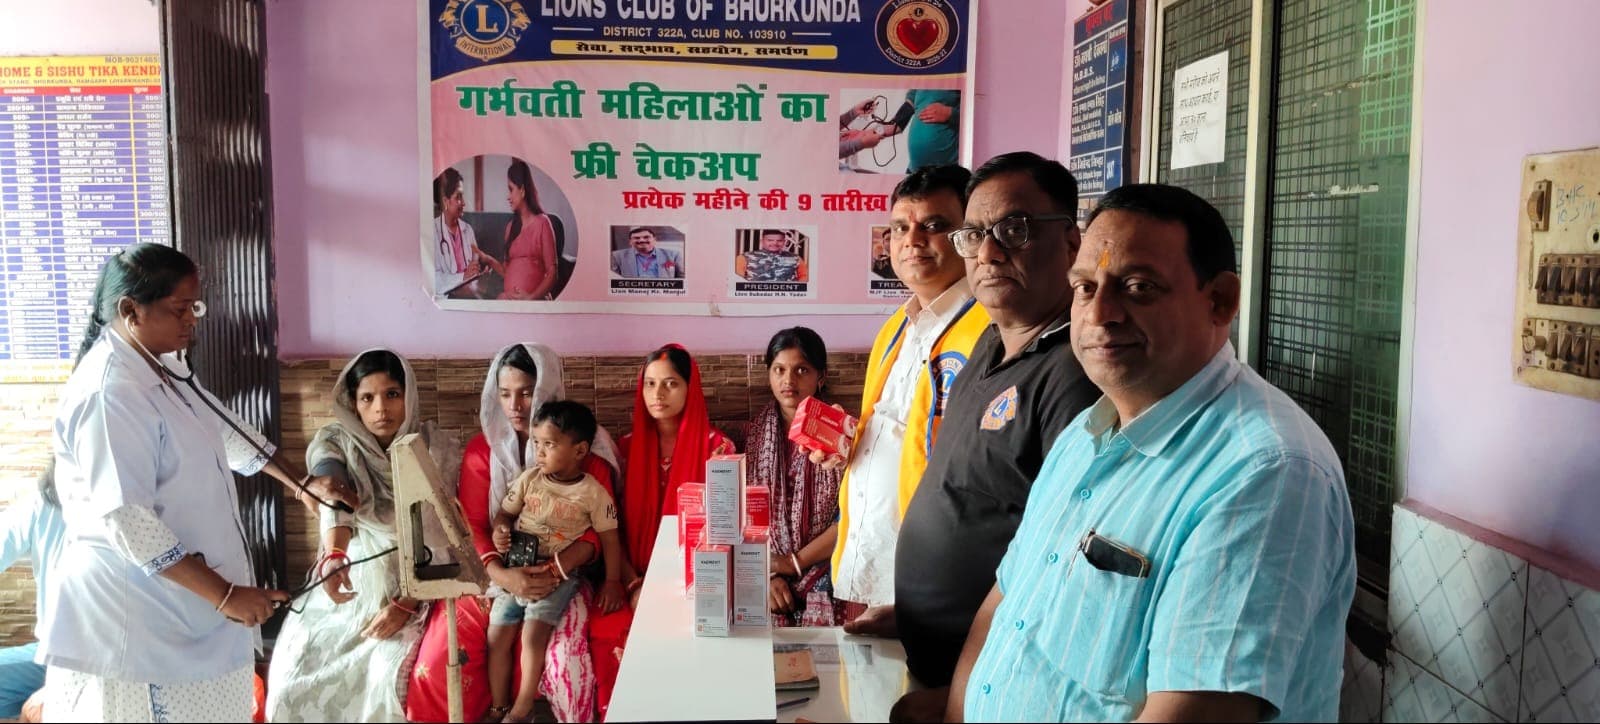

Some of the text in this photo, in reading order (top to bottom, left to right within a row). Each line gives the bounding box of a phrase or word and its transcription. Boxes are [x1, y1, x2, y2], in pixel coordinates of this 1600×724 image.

[475, 4, 499, 33] L
[541, 0, 861, 23] LIONS CLUB OF BHURKUNDA
[603, 26, 787, 40] DISTRICT 322A, CLUB NO. 103910
[458, 38, 513, 57] INTERNATIONAL
[755, 46, 809, 57] समर्पण
[47, 66, 85, 77] SISHU
[89, 65, 118, 77] TIKA
[123, 65, 161, 77] KEND
[456, 78, 829, 122] गर्भवती महिलाओं का
[570, 142, 762, 182] फ्री चेकअप
[622, 187, 889, 212] प्रत्येक महीने की 9 तारीख
[618, 280, 676, 288] SECRETARY
[877, 281, 904, 289] TREA
